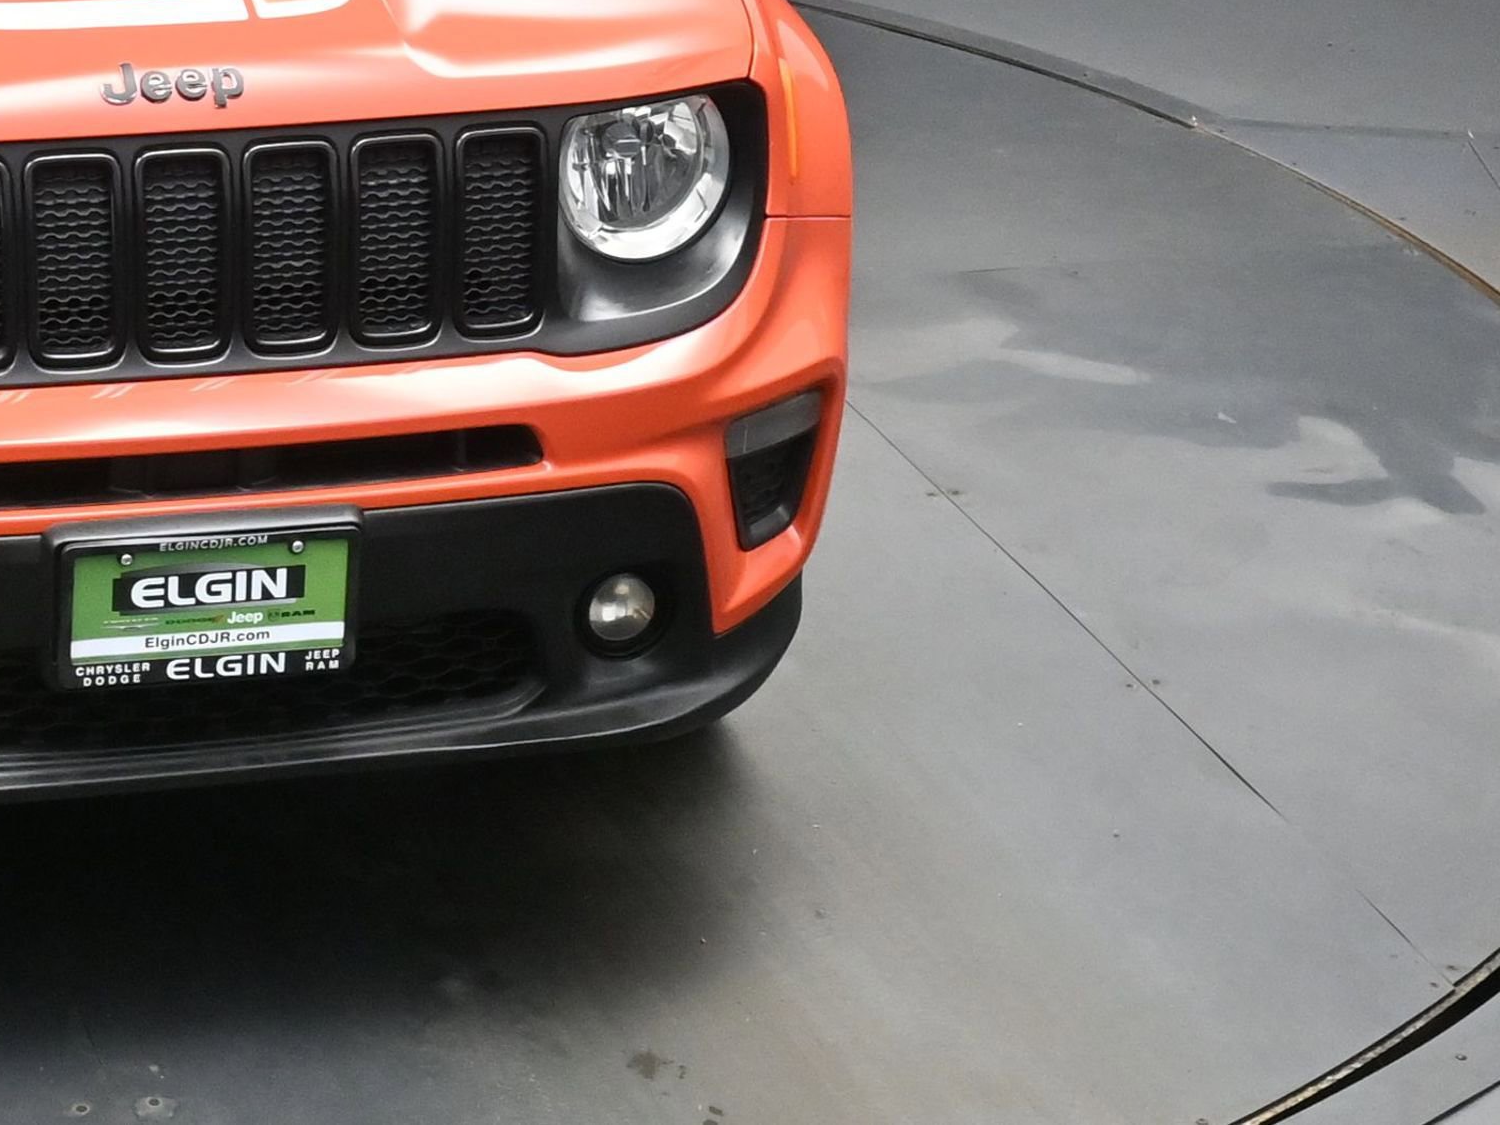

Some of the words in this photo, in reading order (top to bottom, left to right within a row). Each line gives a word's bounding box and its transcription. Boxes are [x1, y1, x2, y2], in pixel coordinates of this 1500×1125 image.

[101, 62, 244, 108] Jeep
[159, 535, 268, 552] ELGINCDJR.COM
[130, 567, 288, 609] ELGIN
[227, 611, 263, 624] Jeep
[145, 629, 270, 650] ElginCDJR.com
[305, 648, 340, 660] JEEP
[75, 662, 150, 676] CHRYSLER
[166, 652, 285, 680] ELGIN
[305, 660, 339, 671] RAM
[83, 674, 140, 687] DODGE
